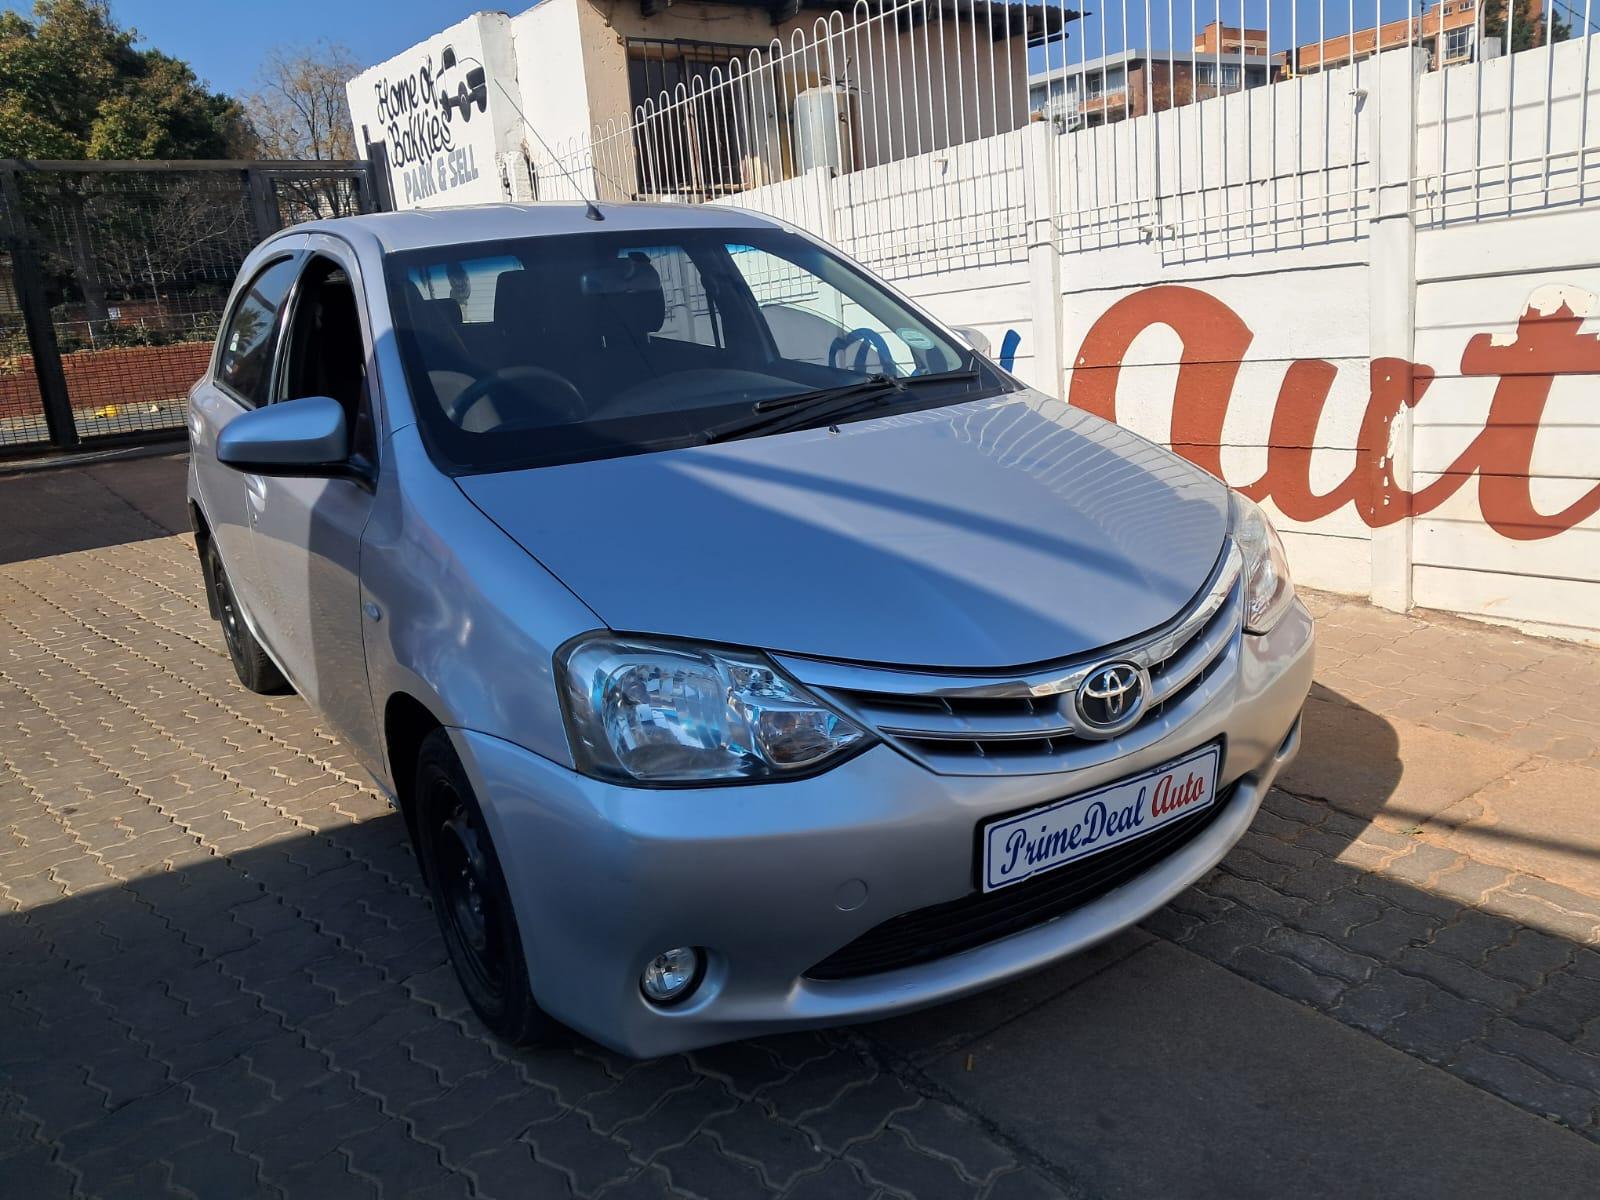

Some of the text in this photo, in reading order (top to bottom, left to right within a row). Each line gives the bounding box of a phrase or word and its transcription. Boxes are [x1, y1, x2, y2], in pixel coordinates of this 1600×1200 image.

[374, 73, 419, 125] Home
[403, 144, 479, 204] PARK & SELL
[1152, 772, 1204, 817] Auto
